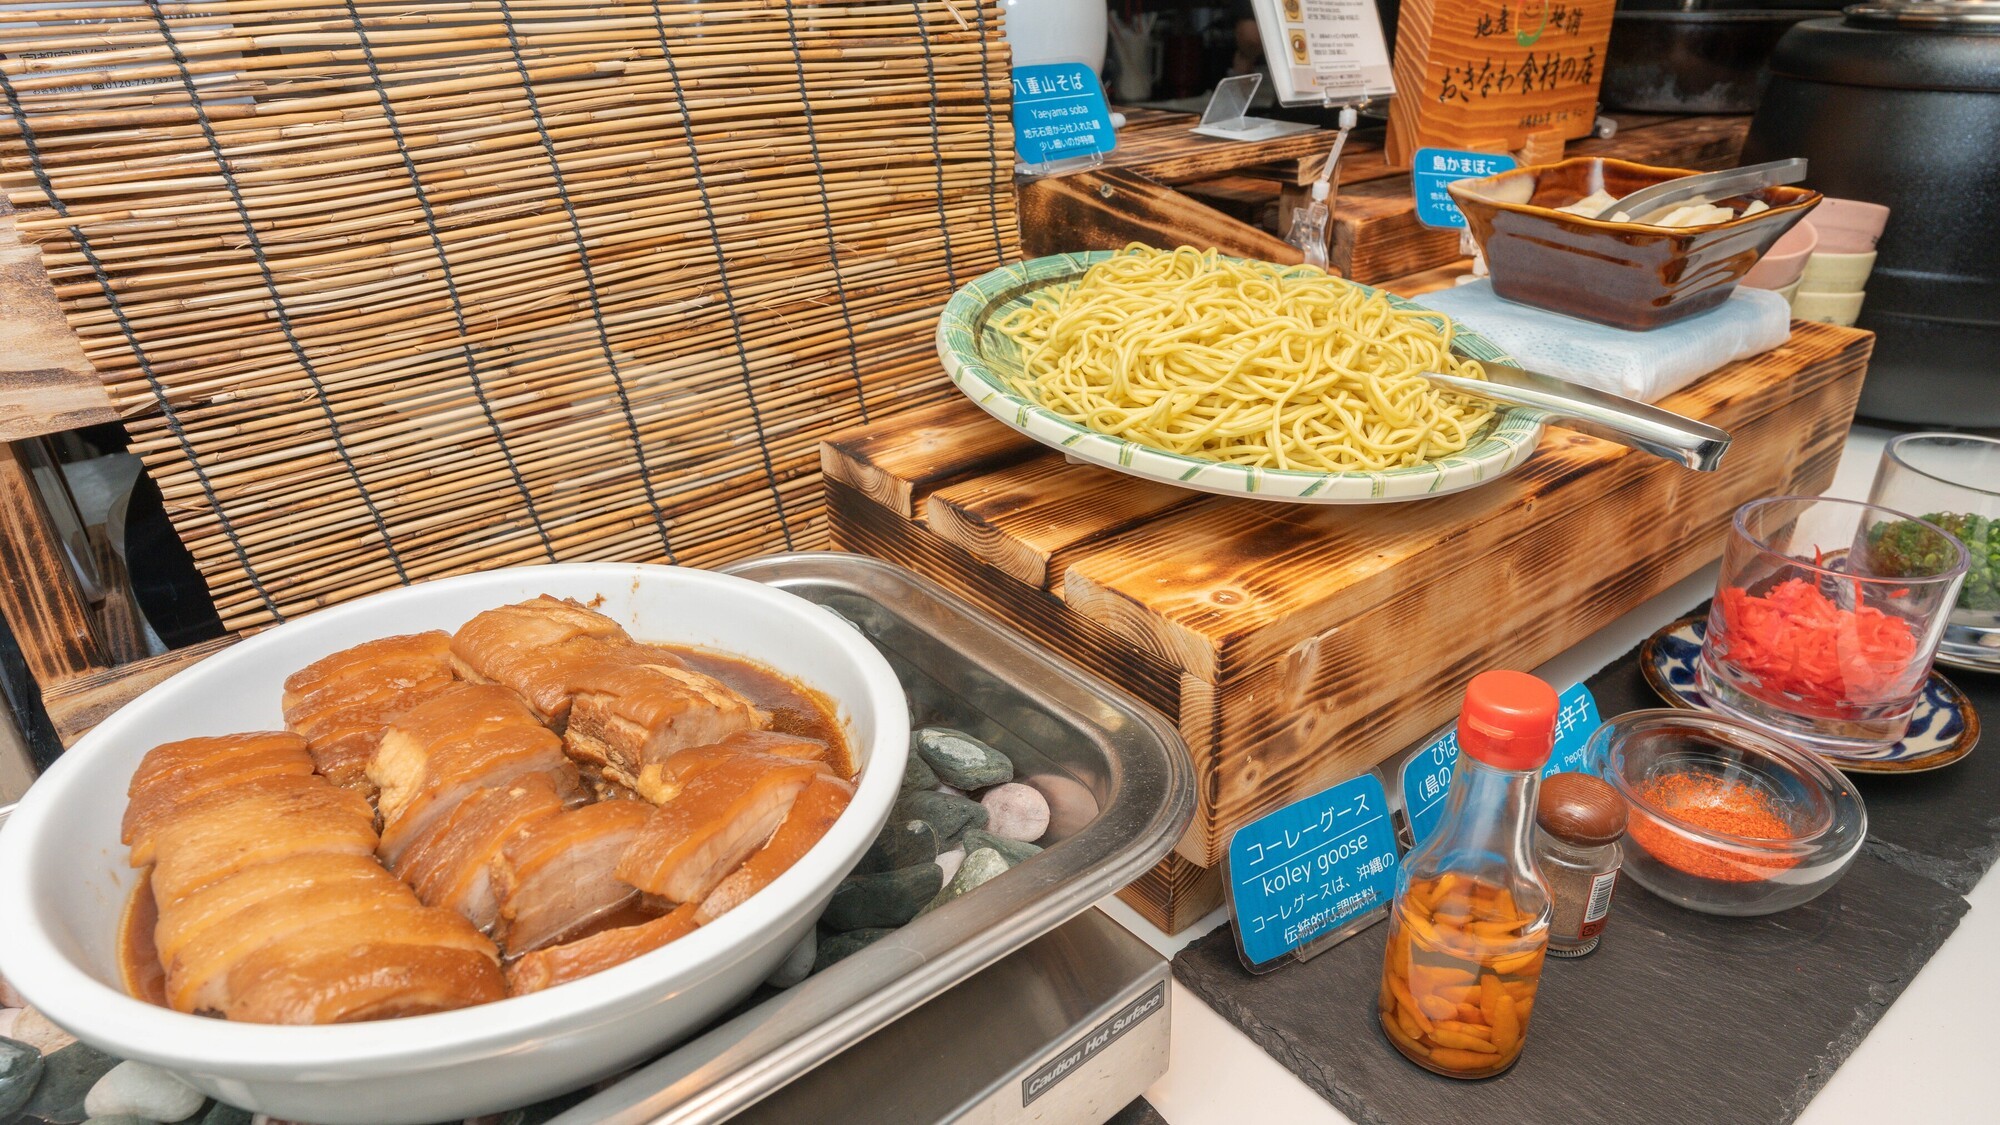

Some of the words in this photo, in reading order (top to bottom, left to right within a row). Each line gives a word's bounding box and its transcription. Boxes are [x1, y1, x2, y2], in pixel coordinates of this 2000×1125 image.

[1012, 72, 1084, 96] 八重山そば
[1439, 46, 1596, 102] おきなわ食材の店
[1030, 107, 1068, 120] Yaeyama
[1069, 104, 1089, 116] soba
[1432, 155, 1499, 175] 島かまぼこ
[1246, 793, 1370, 866] コーレーグース
[1262, 860, 1311, 897] koley
[1317, 834, 1369, 876] goose
[1028, 1051, 1081, 1095] Caution
[1084, 1029, 1110, 1056] Hot
[1111, 993, 1160, 1035] Surface
